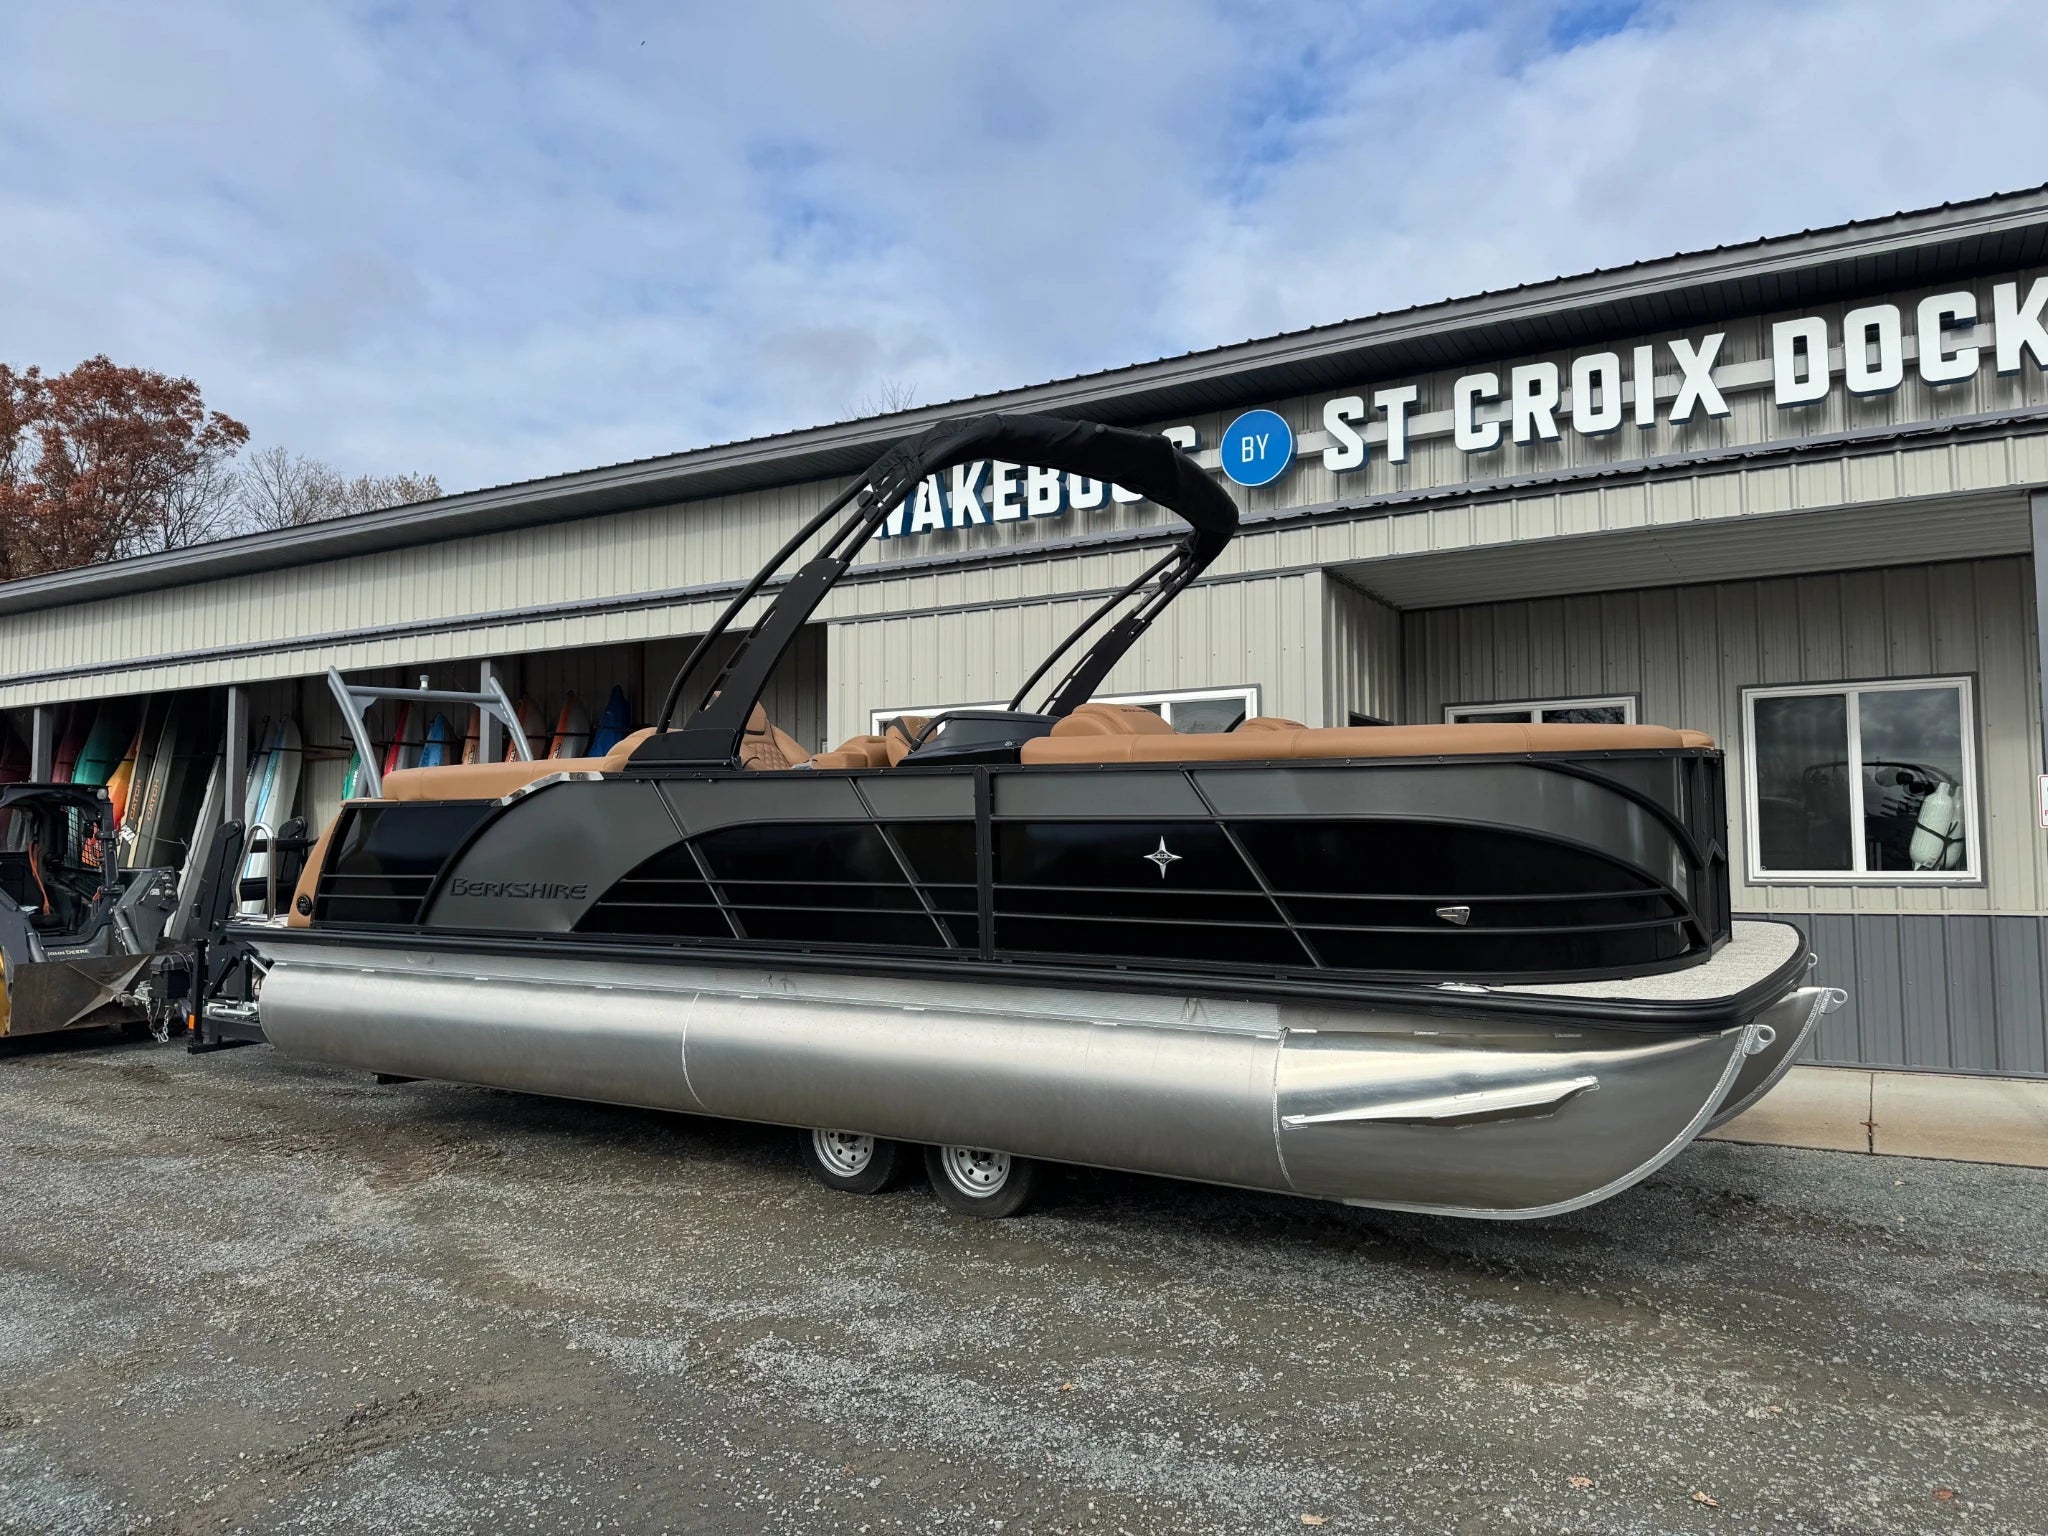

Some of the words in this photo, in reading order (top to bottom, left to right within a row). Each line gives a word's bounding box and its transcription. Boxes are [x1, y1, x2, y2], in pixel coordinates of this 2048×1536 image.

[1241, 433, 1269, 463] BY
[1323, 385, 1419, 473] ST
[1453, 333, 1731, 453] CROIX
[1772, 277, 2048, 408] DOCK
[130, 779, 142, 820] CATCH
[147, 779, 159, 820] CATCH
[451, 878, 588, 900] BERKSHIRE
